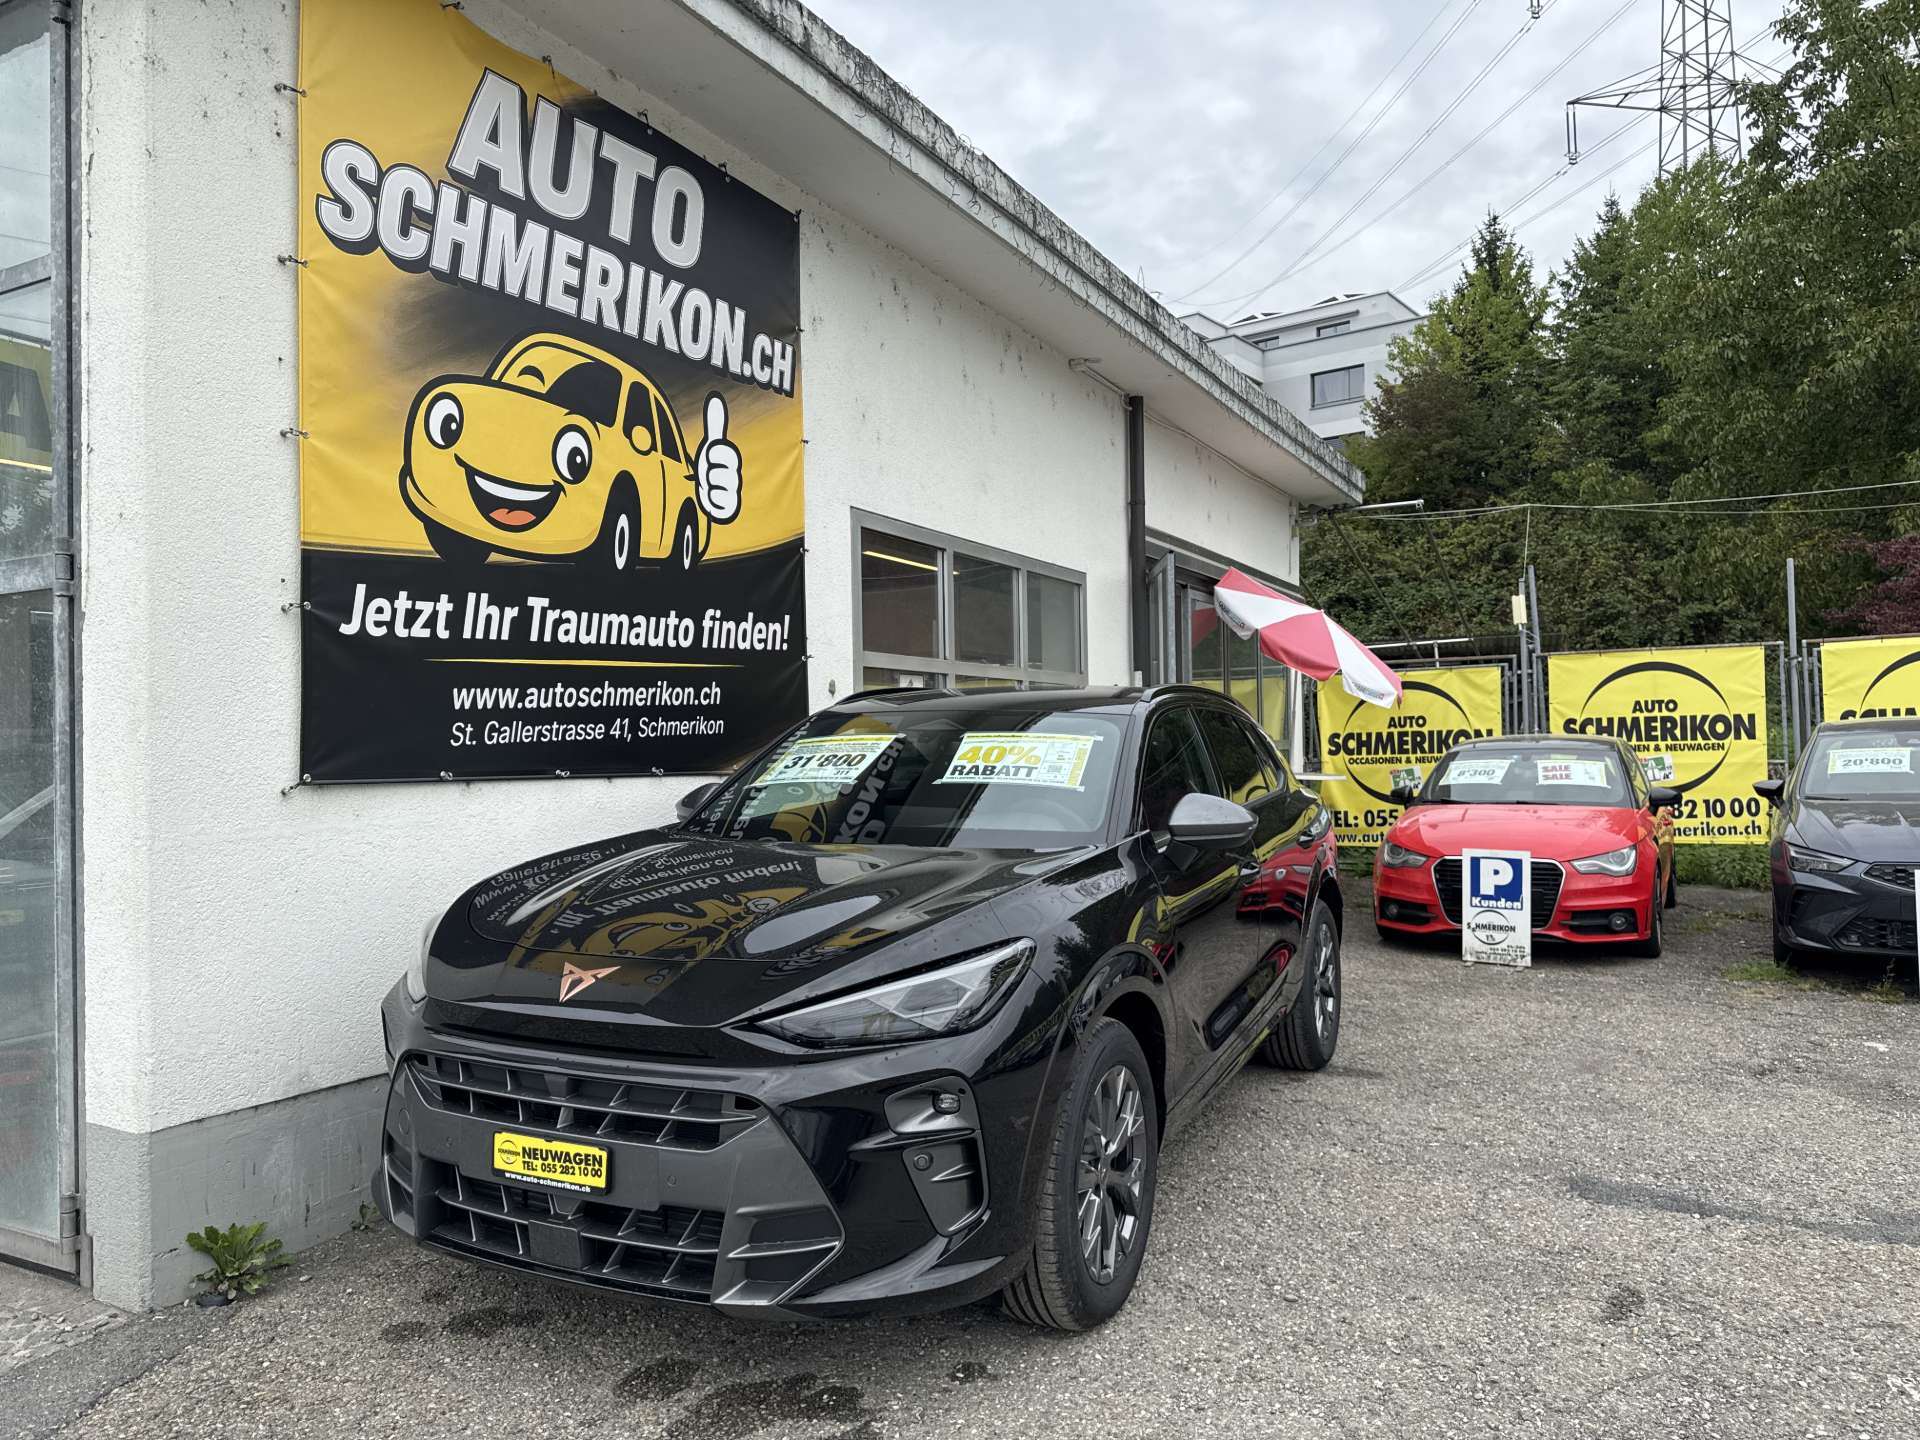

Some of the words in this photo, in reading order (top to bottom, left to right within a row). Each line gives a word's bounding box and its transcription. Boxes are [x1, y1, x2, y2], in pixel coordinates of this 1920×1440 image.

[449, 67, 705, 268] AUTO
[317, 139, 796, 396] SCHMERIKON.CH
[338, 583, 453, 639] Jetzt
[462, 592, 519, 641] Ihr
[527, 596, 695, 649] Traumauto
[701, 609, 791, 652] finden!
[453, 680, 721, 710] www.autoschmerikon.ch
[1632, 699, 1679, 714] AUTO
[1388, 715, 1427, 729] AUTO
[450, 721, 477, 747] St.
[484, 720, 605, 745] Gallerstrasse
[609, 717, 632, 742] 41,
[638, 716, 724, 738] Schmerikon
[957, 745, 1041, 765] 40%
[1654, 743, 1661, 752] &
[1665, 742, 1725, 752] NEUWAGEN
[783, 753, 867, 770] 31'800
[1348, 756, 1403, 765] OCCASIONEN
[1405, 756, 1412, 764] &
[1415, 756, 1442, 764] NEUW
[1841, 757, 1903, 767] 20'800
[950, 764, 1039, 777] RABATT
[1457, 768, 1495, 777] 8'300
[1703, 798, 1726, 819] 10
[1730, 797, 1760, 817] 00
[1331, 810, 1359, 828] EL:
[1479, 858, 1514, 896] P
[1471, 896, 1522, 909] Kunden
[521, 1146, 603, 1168] NEUWAGEN
[522, 1160, 538, 1172] TEL:
[540, 1163, 557, 1174] 055
[559, 1165, 576, 1176] 282
[578, 1167, 589, 1177] 10
[590, 1168, 603, 1178] 00
[504, 1172, 591, 1193] www.auto-schmerikon.ch
